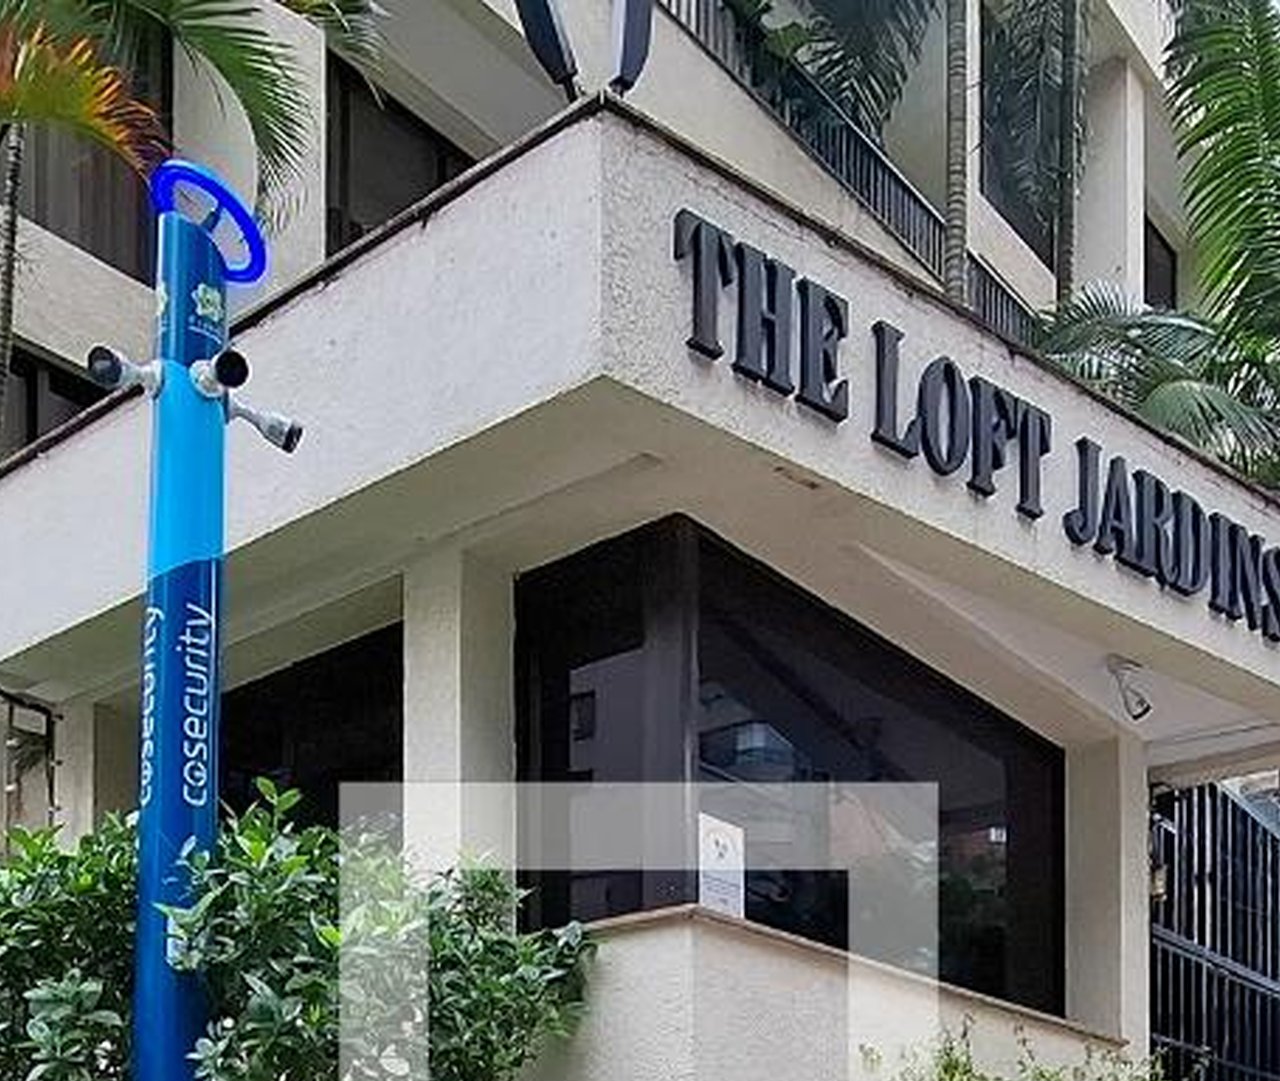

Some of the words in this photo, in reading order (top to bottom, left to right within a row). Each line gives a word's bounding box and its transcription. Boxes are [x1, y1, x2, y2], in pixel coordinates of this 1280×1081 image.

[673, 207, 850, 423] THE
[871, 319, 1053, 520] LOFT
[175, 602, 214, 806] cosecurity
